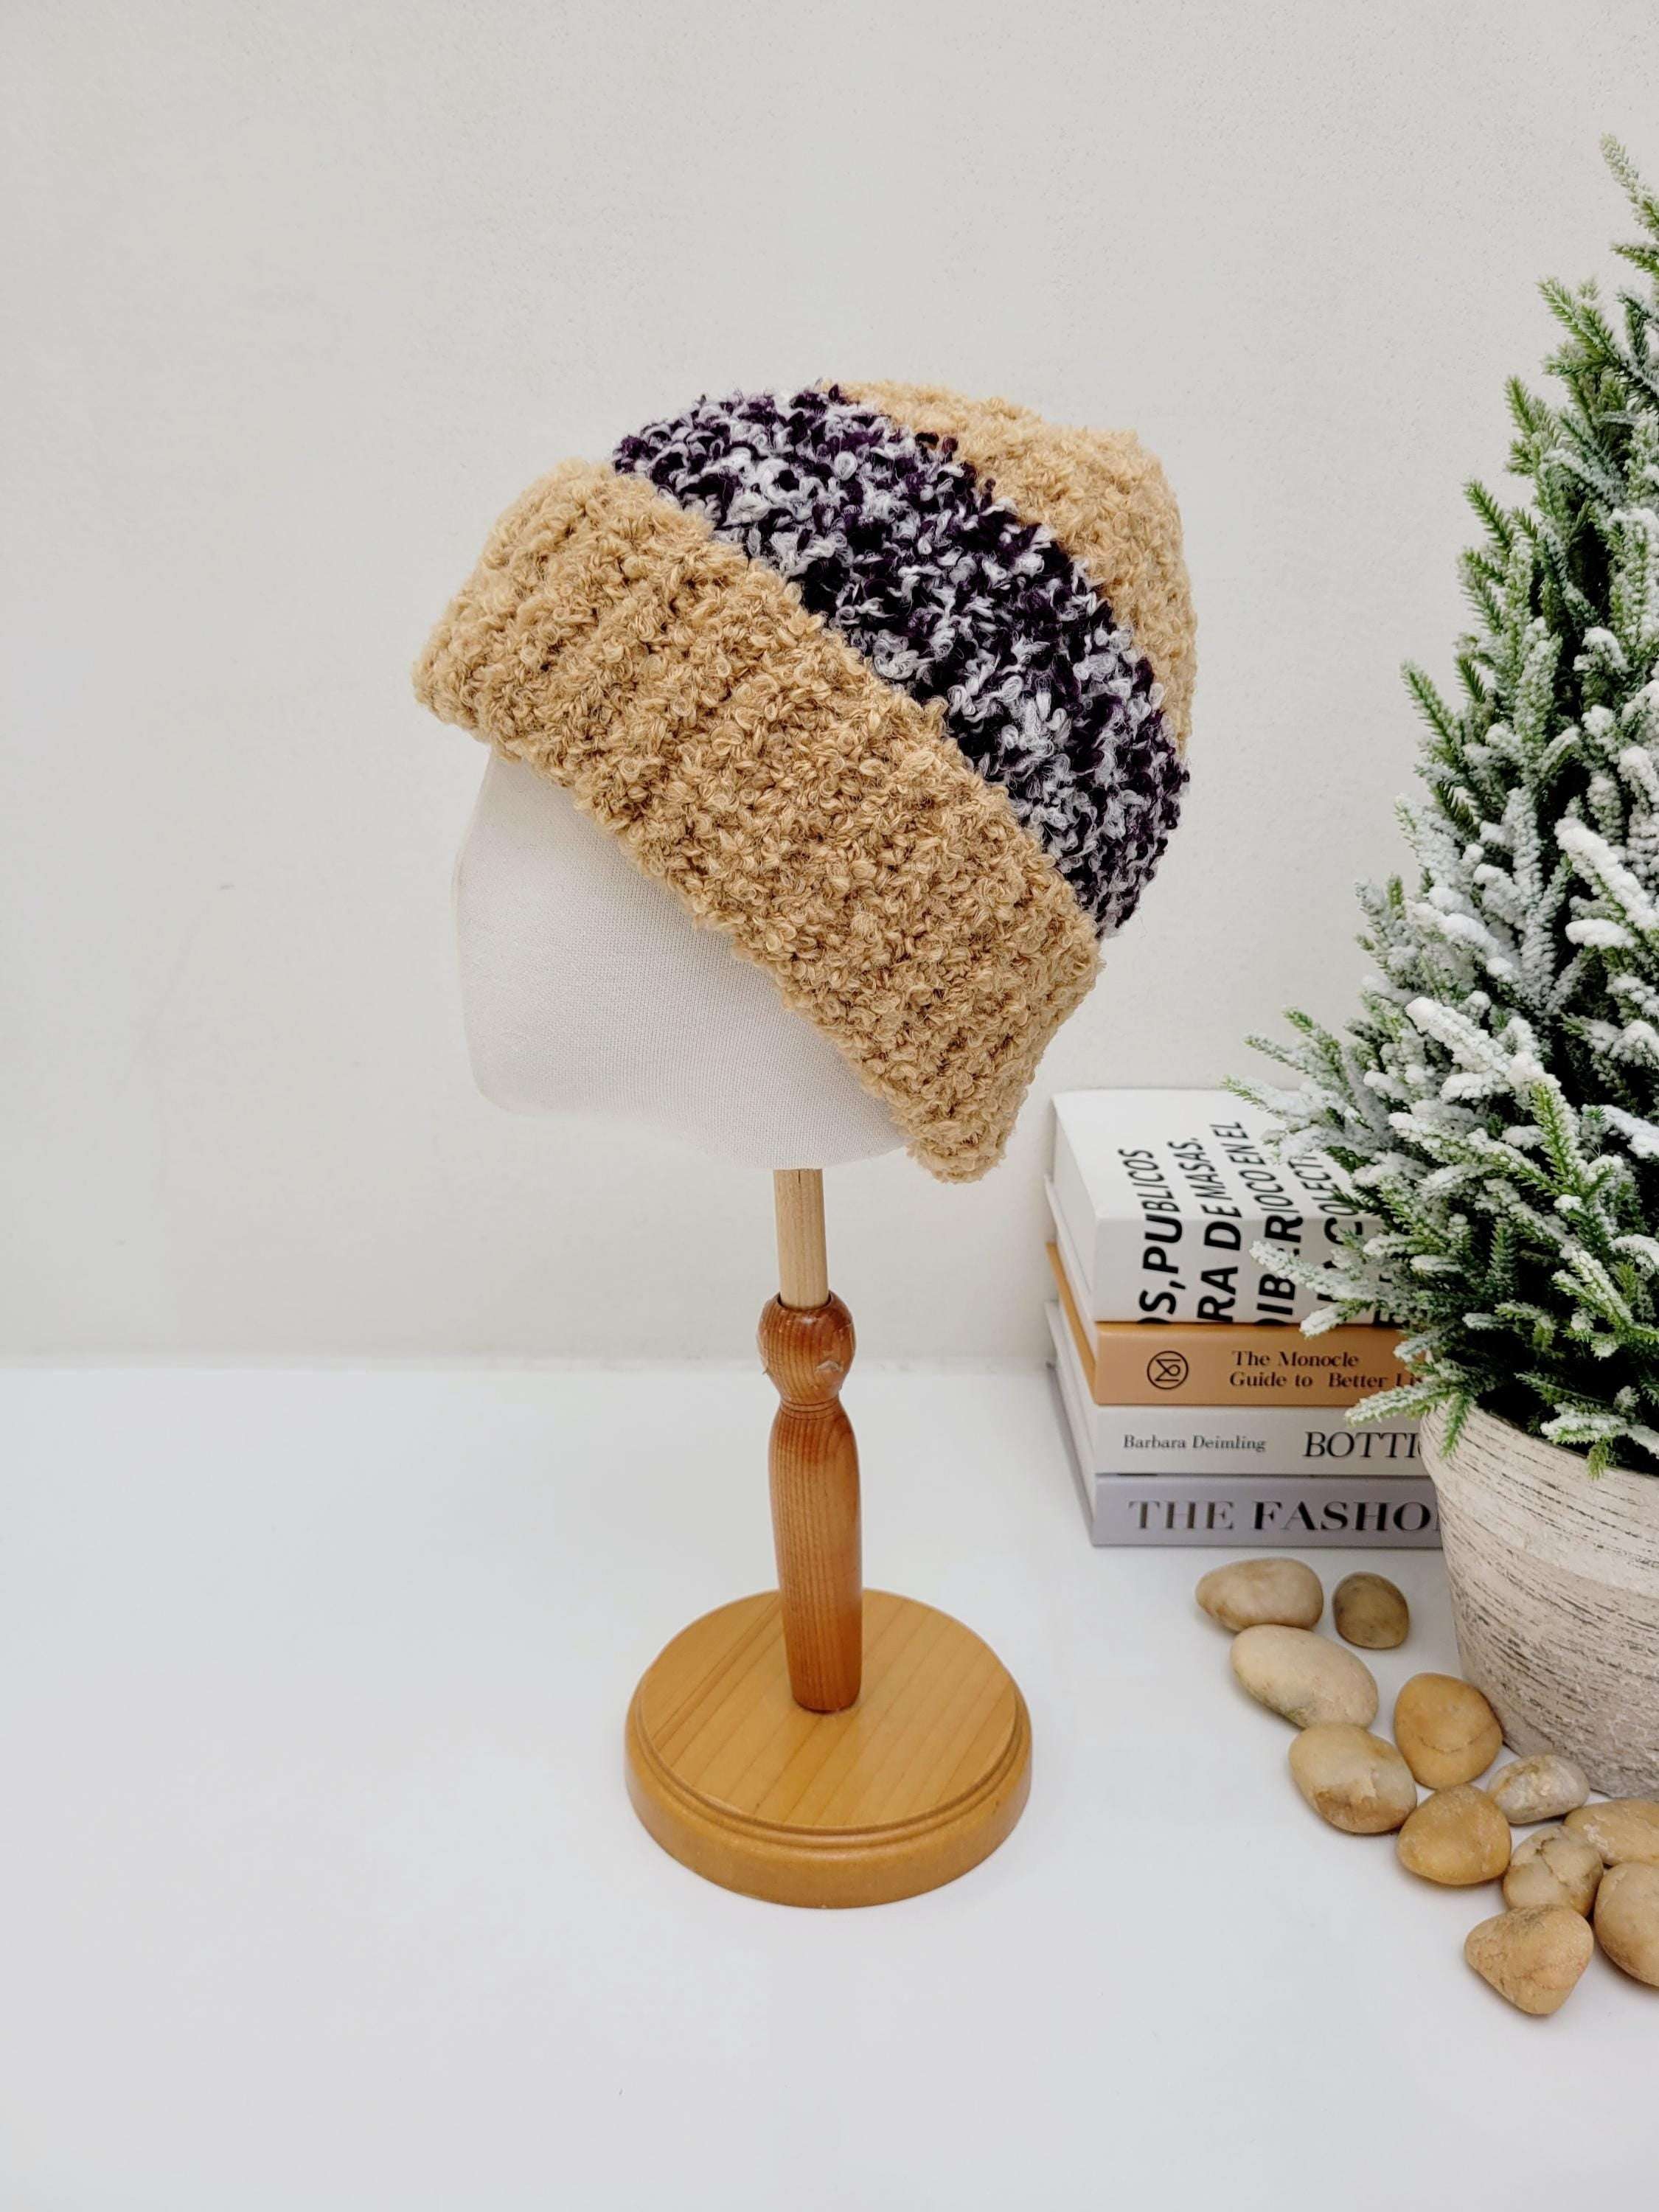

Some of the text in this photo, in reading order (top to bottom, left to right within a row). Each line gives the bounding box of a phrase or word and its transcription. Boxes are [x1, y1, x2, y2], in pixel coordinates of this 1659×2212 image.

[1209, 1121, 1249, 1139] EL
[1220, 1143, 1266, 1165] EN
[1200, 1203, 1243, 1251] DE
[1197, 1265, 1239, 1323] RA
[1231, 1350, 1360, 1367] The Monocle
[1229, 1371, 1287, 1387] Guide
[1295, 1374, 1314, 1388] to
[1328, 1373, 1389, 1388] Better
[1123, 1434, 1267, 1453] Barbara Deimling
[1302, 1430, 1421, 1458] BOTTI
[1128, 1500, 1234, 1530] THE
